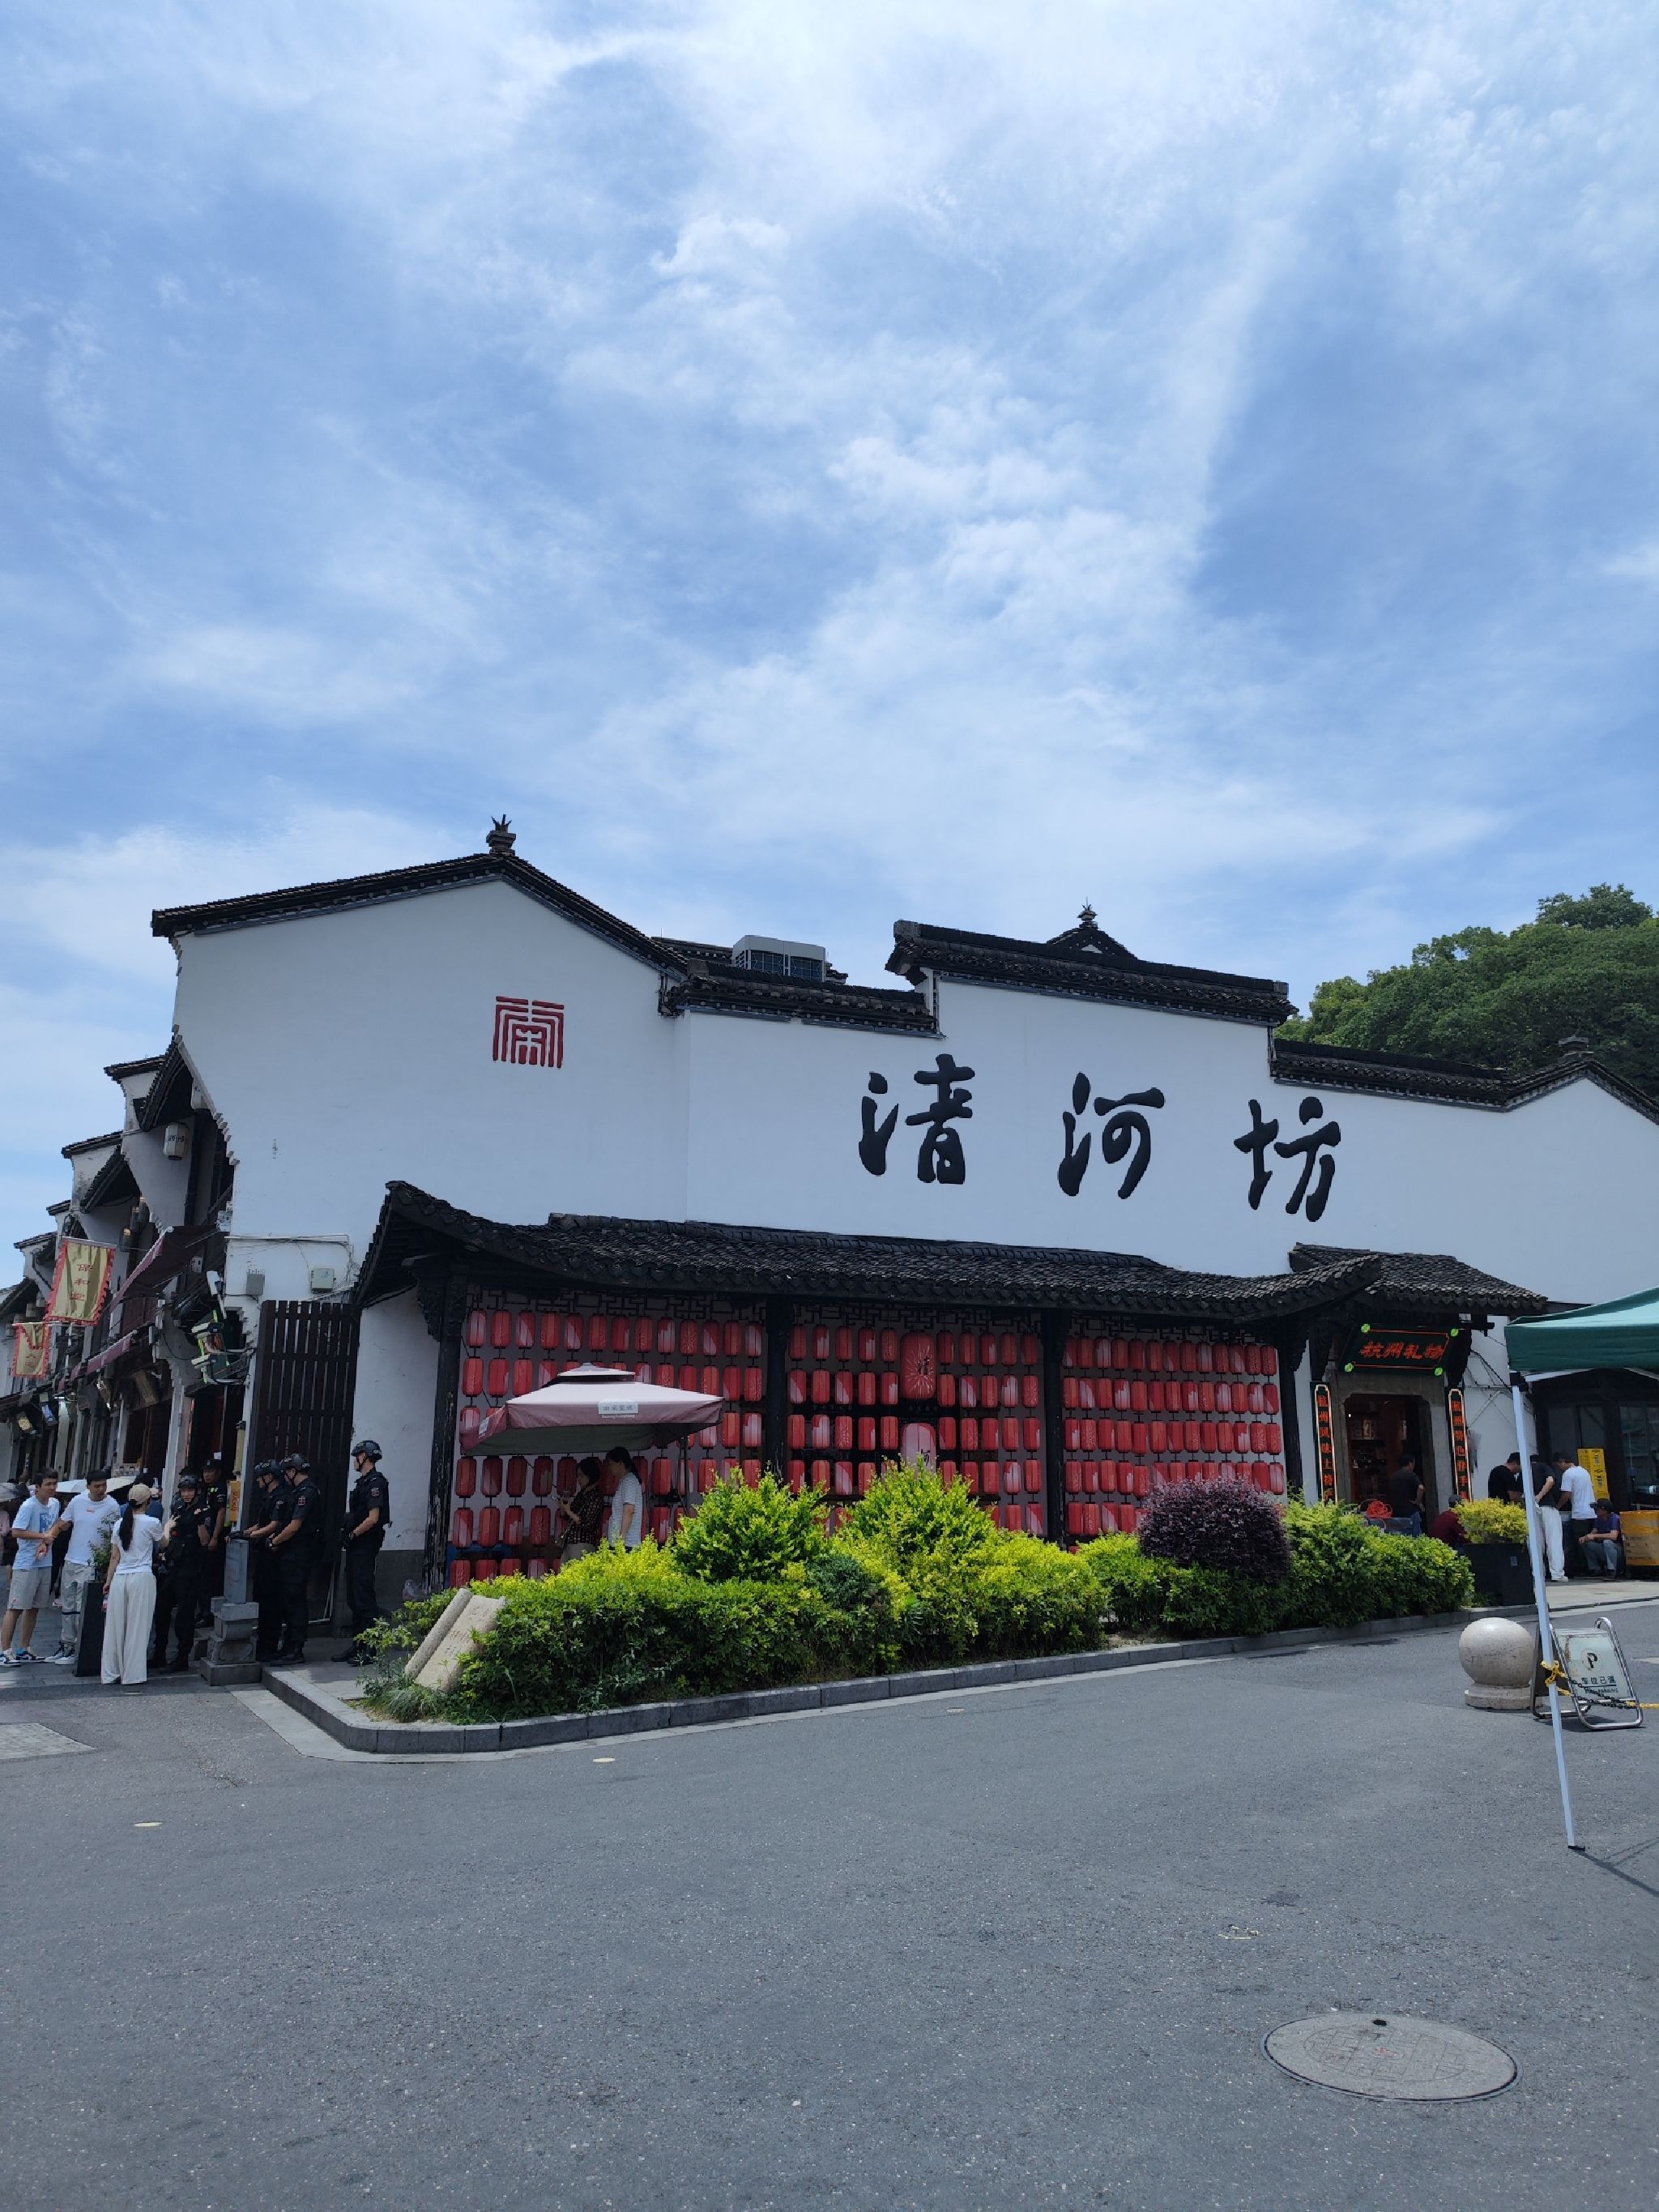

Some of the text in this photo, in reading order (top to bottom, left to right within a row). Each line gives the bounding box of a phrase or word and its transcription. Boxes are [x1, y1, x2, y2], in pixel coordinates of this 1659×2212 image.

[859, 1053, 1341, 1222] 清河坊
[1359, 1341, 1444, 1360] 杭州礼物
